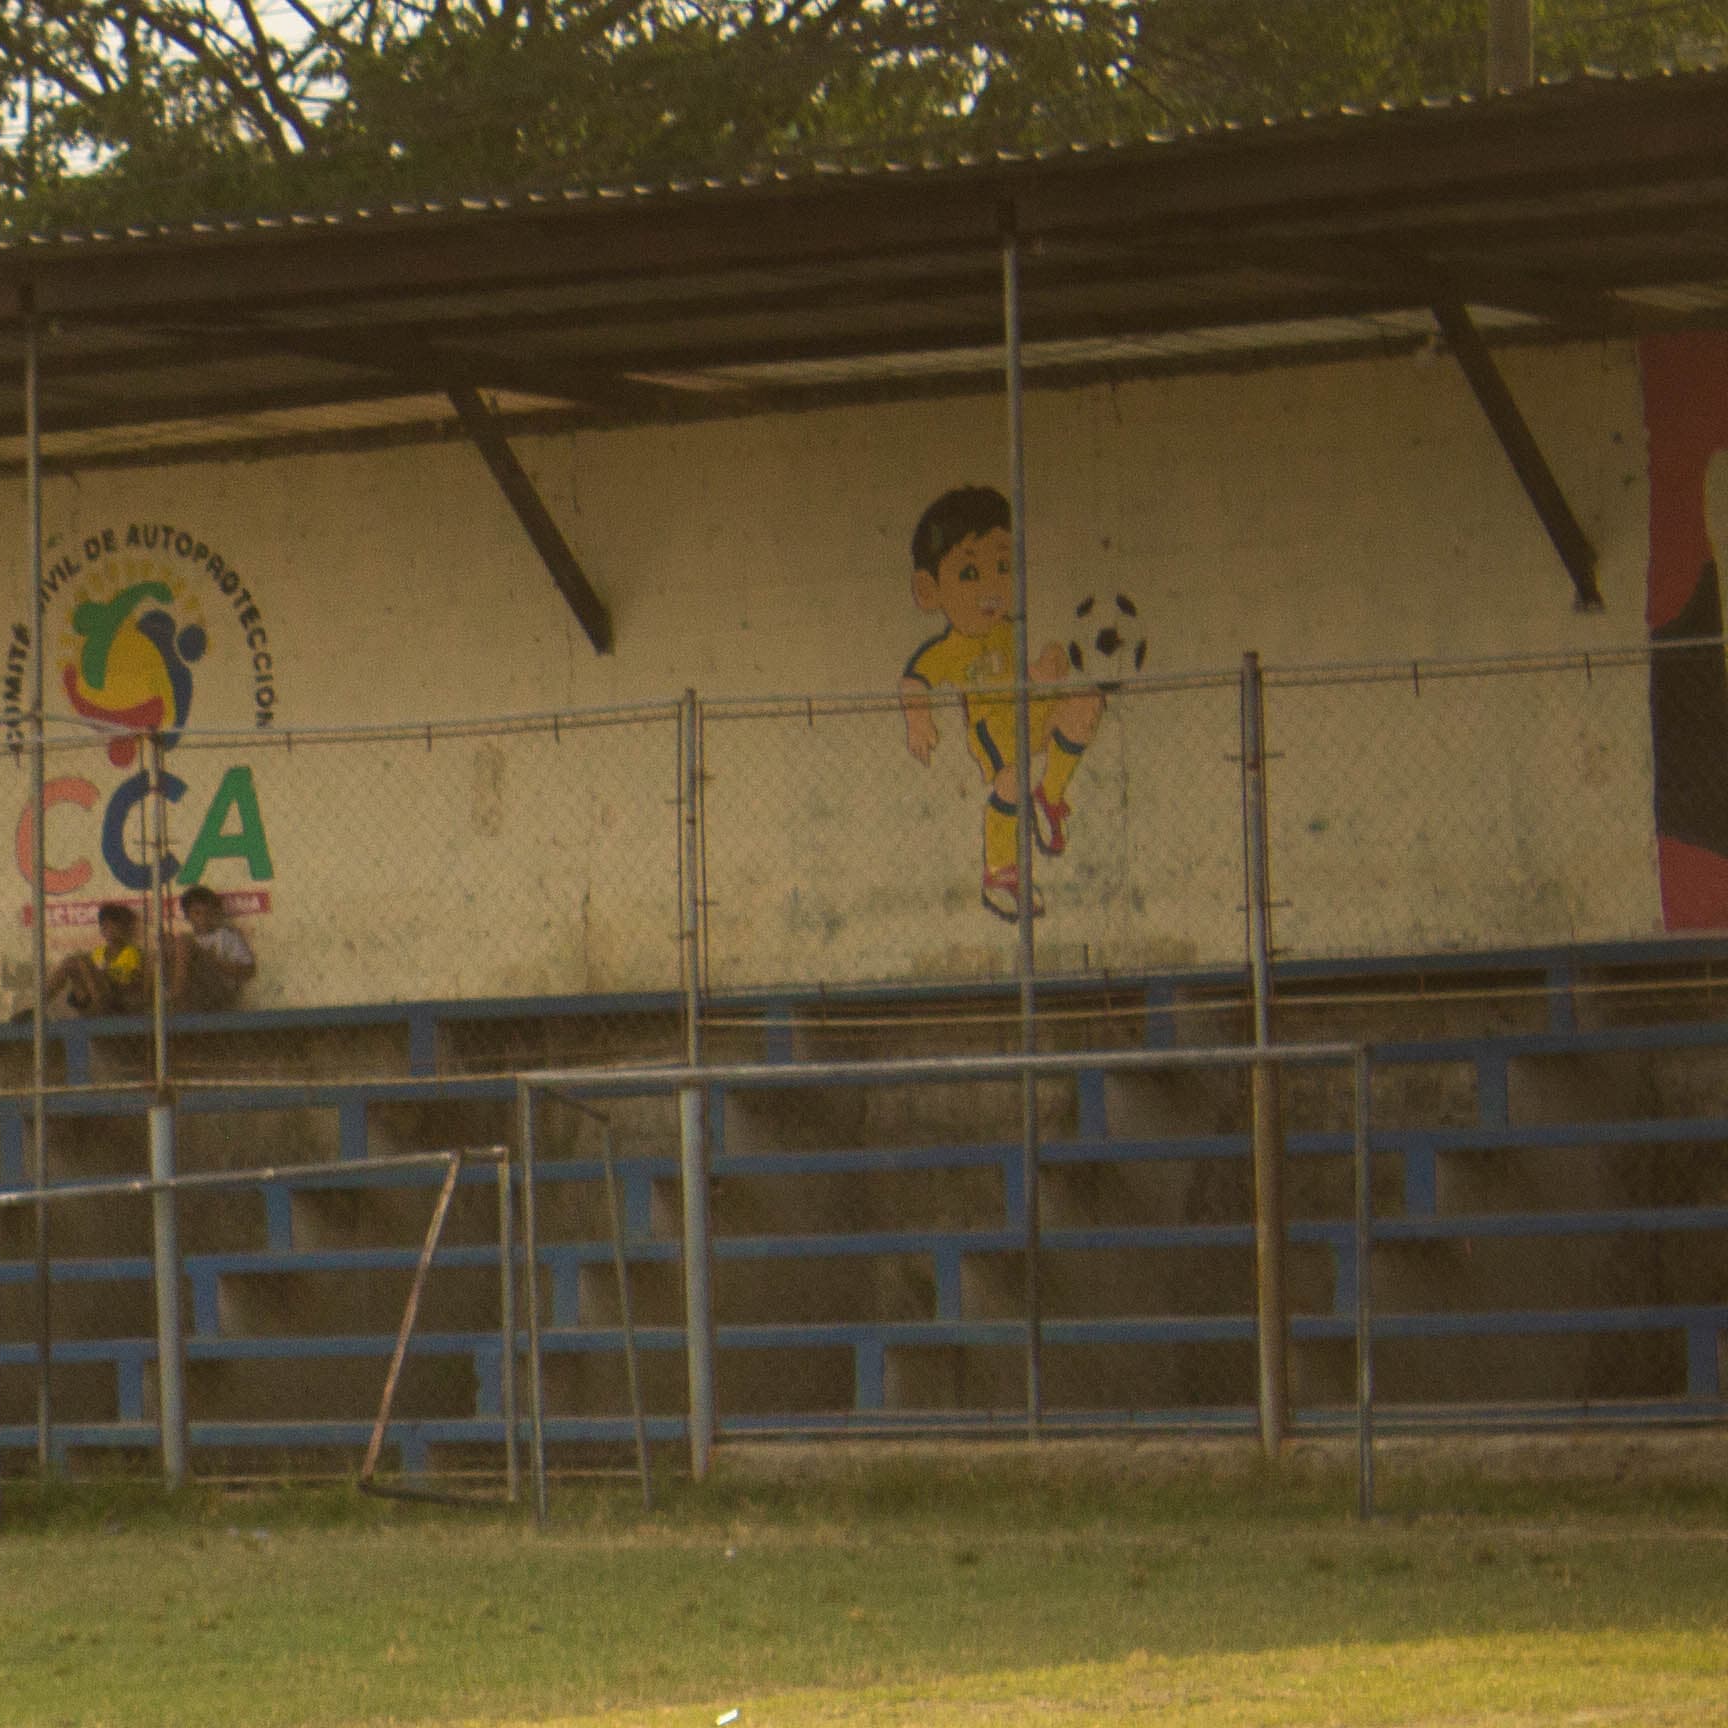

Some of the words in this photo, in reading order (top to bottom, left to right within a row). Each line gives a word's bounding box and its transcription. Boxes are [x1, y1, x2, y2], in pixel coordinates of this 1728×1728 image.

[38, 554, 82, 612] IVIL
[83, 528, 118, 562] DE
[126, 523, 275, 730] AUTOPROTECCION
[15, 765, 274, 895] CCA
